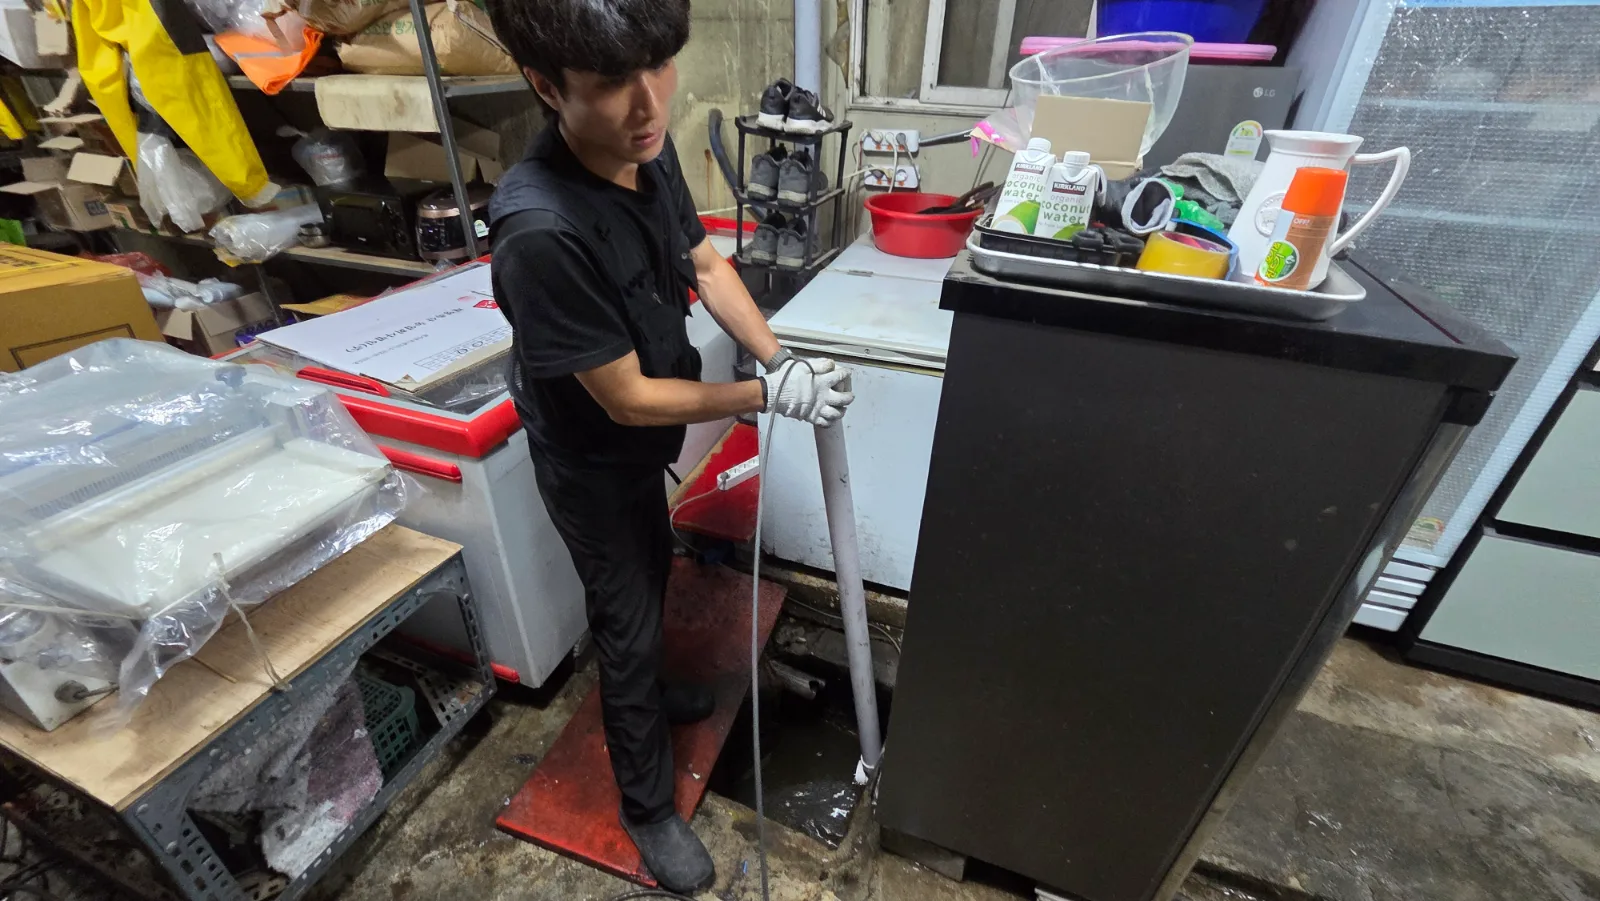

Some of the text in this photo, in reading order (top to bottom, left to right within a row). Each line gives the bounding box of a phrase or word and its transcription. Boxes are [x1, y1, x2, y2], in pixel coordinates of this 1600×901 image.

[1015, 163, 1044, 172] KIRKLAND
[1012, 173, 1041, 182] organic
[1006, 180, 1045, 193] oconu
[1053, 183, 1086, 192] KIRKLAND
[1004, 189, 1040, 201] water
[1050, 194, 1083, 204] organic
[1043, 211, 1083, 224] water
